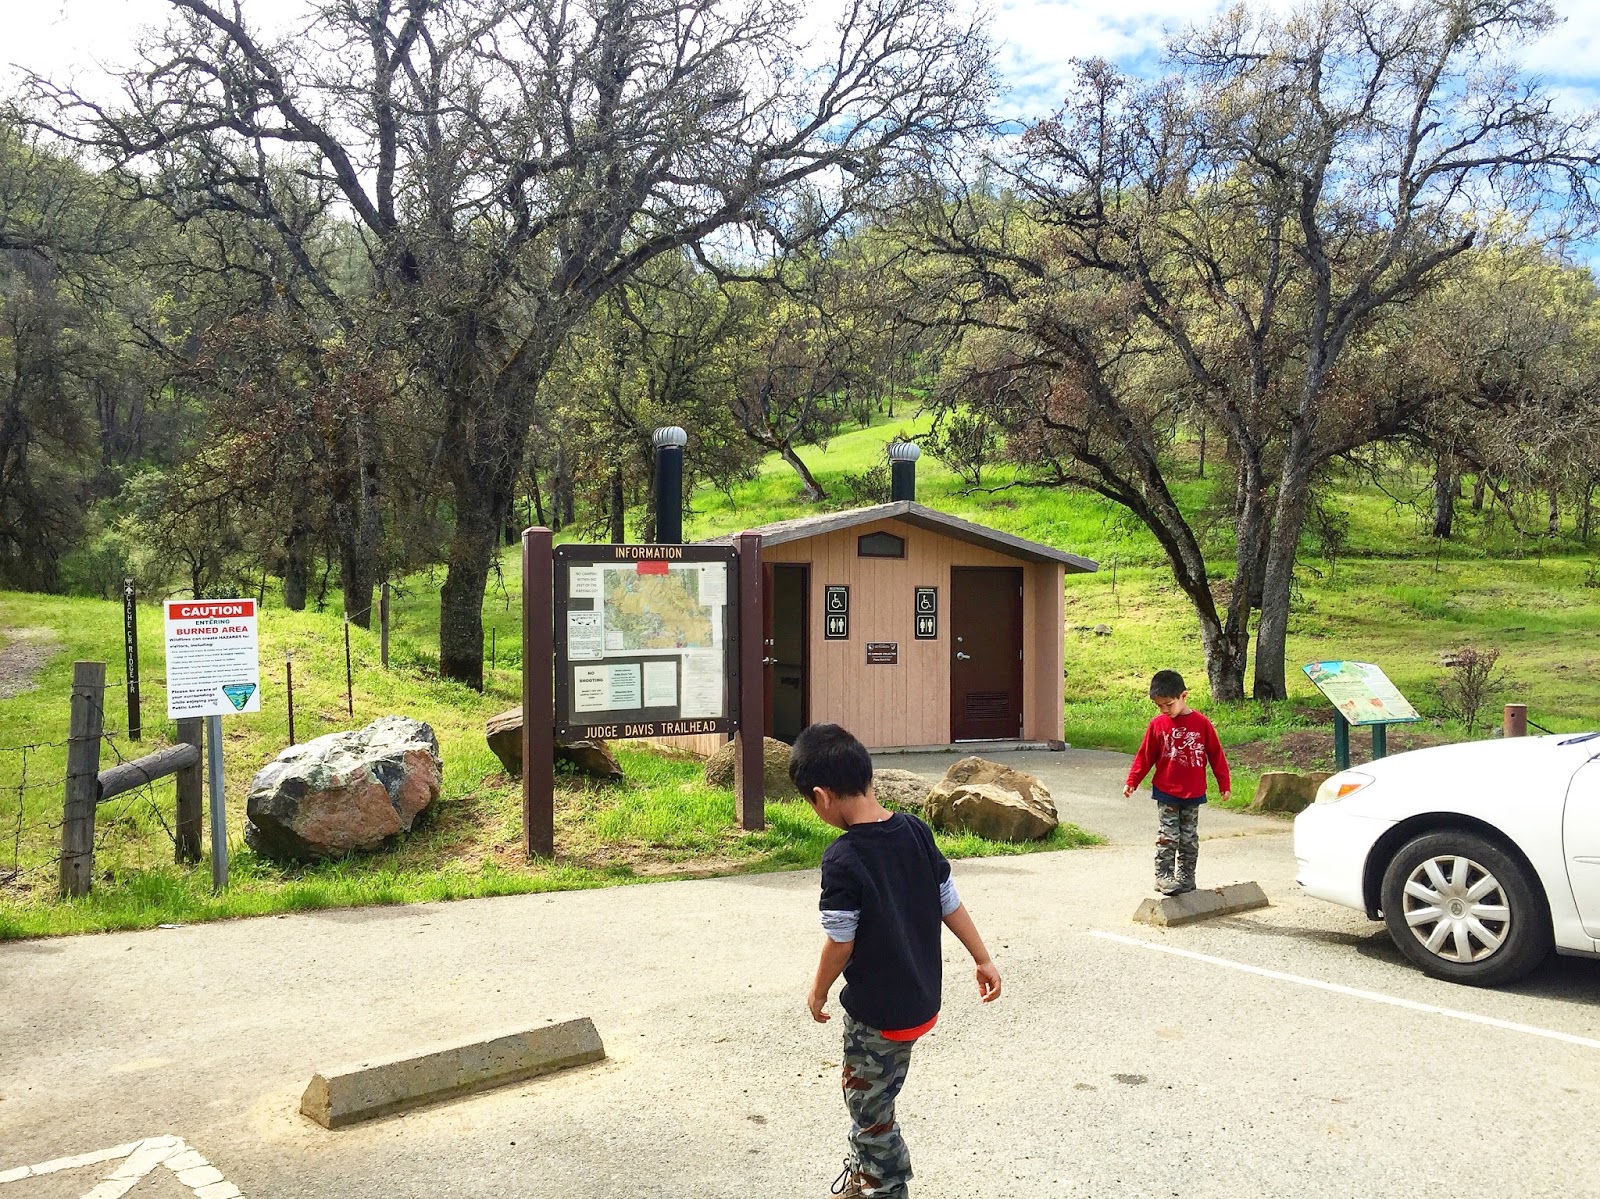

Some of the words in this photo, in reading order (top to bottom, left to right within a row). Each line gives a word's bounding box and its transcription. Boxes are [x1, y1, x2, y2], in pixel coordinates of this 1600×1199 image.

[615, 547, 683, 558] INFORMATION
[181, 605, 243, 617] CAUTION
[176, 627, 219, 636] BURNED
[221, 626, 249, 634] AREA
[584, 725, 618, 739] JUDGE
[625, 723, 655, 736] DAVIS
[661, 720, 716, 734] TRAILHEAD
